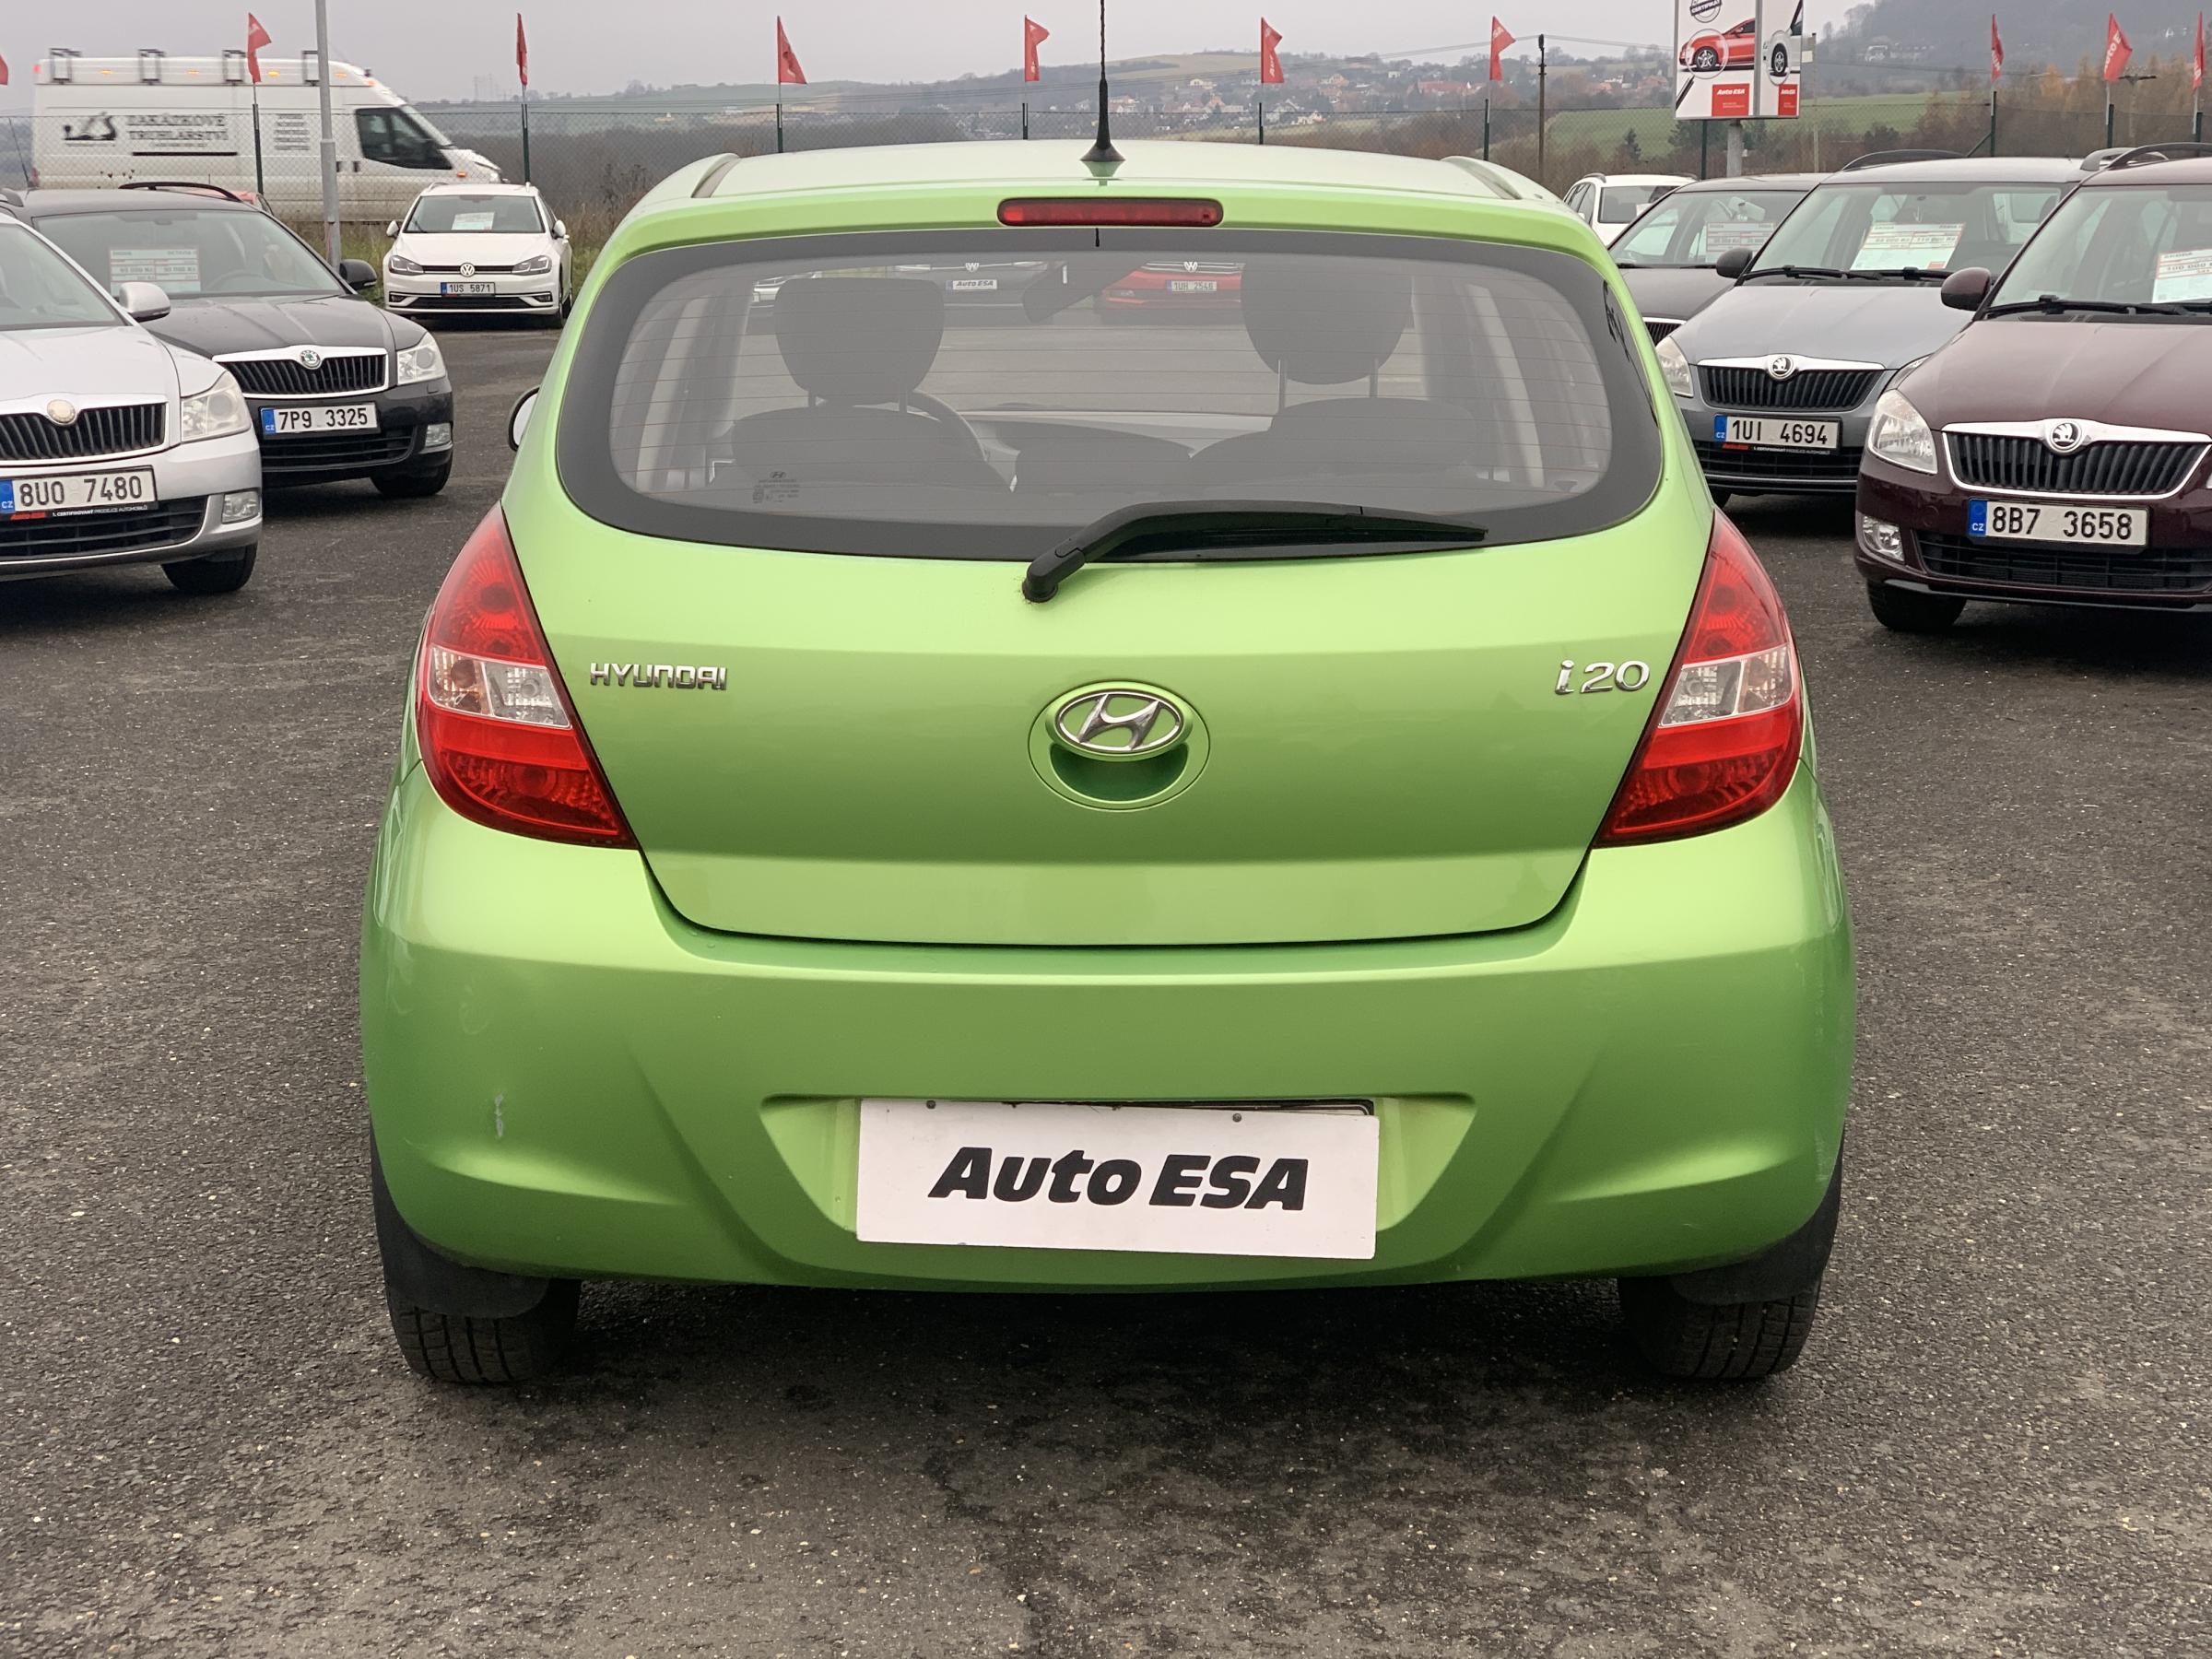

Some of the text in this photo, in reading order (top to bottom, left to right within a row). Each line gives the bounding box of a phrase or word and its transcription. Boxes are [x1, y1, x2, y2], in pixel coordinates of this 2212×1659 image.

[449, 284, 490, 292] 1US 5871
[278, 410, 312, 430] 7P9
[325, 407, 368, 427] 3325
[1733, 419, 1762, 441] 1UI
[1780, 423, 1828, 444] 4694
[83, 476, 142, 502] 7480
[1971, 506, 2132, 540] CZ 8B7 3658
[590, 663, 727, 690] HYUNDAI
[1555, 659, 1650, 695] i20
[927, 1147, 1309, 1211] Auto ESA
